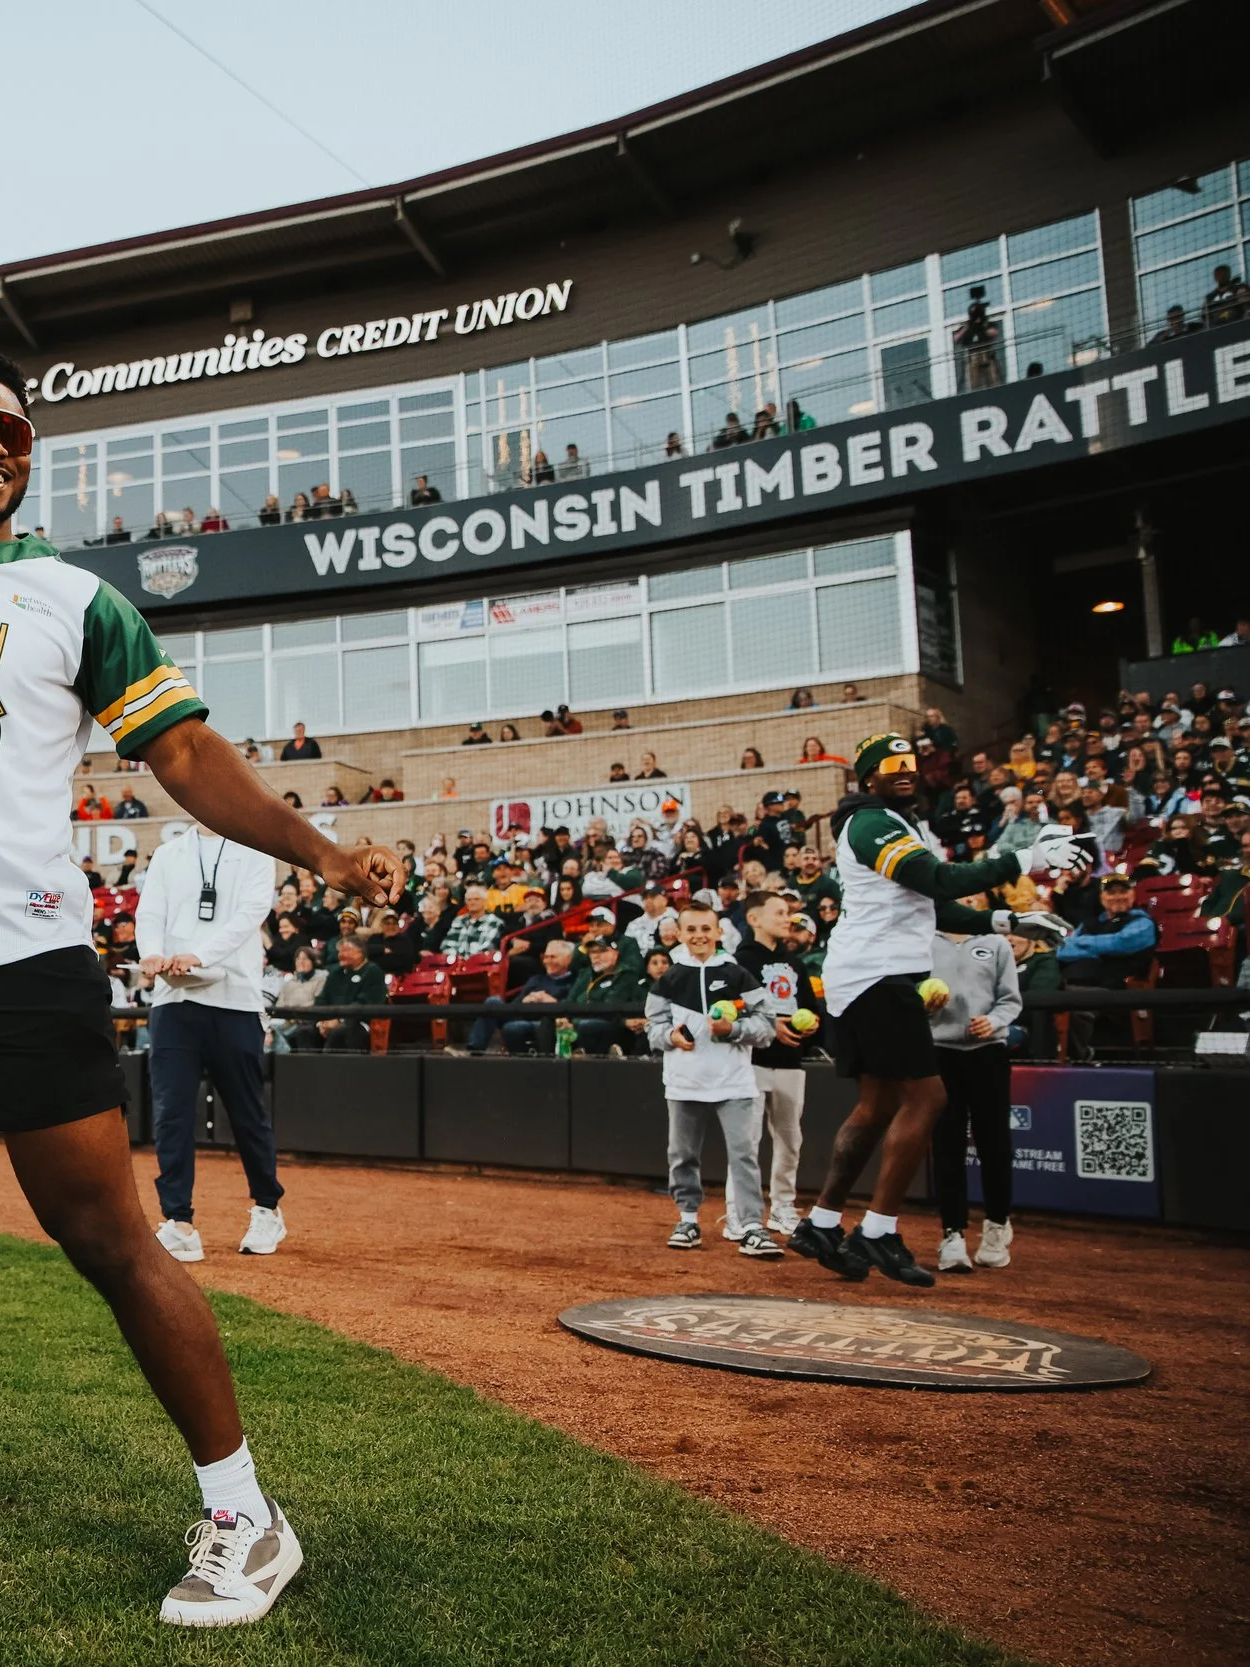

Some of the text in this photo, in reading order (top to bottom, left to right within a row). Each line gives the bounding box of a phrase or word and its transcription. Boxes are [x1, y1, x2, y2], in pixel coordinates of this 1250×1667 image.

[41, 328, 306, 402] Communities
[316, 308, 449, 358] CREDIT
[454, 279, 573, 334] UNION
[303, 340, 1250, 576] WISCONSIN TIMBER RATTLE
[542, 788, 684, 828] JOHNSON
[1012, 1160, 1066, 1172] AME FREE
[1015, 1148, 1062, 1160] STREAM
